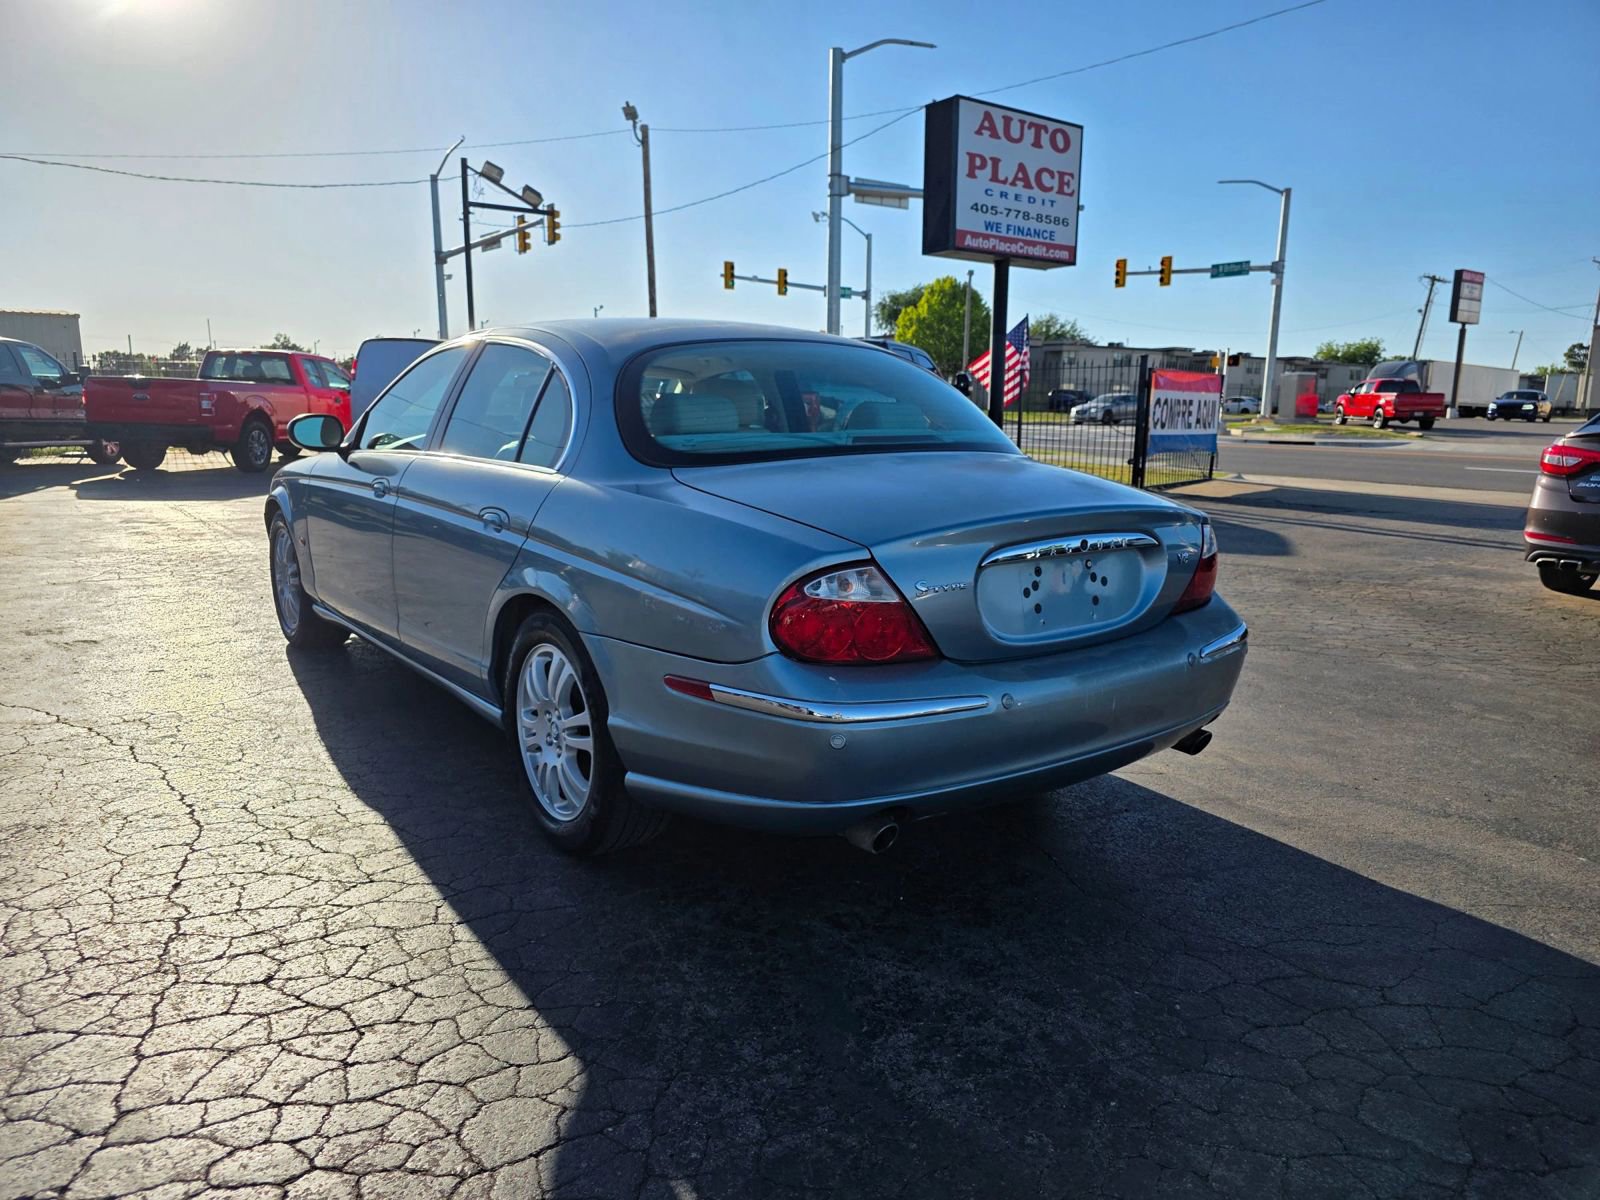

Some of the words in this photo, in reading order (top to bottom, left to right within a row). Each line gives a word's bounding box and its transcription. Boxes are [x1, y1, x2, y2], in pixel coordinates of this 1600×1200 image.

[974, 110, 1071, 154] AUTO
[965, 151, 1075, 197] PLACE
[984, 188, 1057, 208] CREDIT
[970, 202, 1070, 227] 405-778-8586
[984, 219, 1003, 234] WE
[1006, 223, 1056, 241] FINANCE
[964, 234, 1069, 259] AutoPlaceCredit.com
[1152, 397, 1194, 430] COMPRE
[1194, 399, 1217, 429] AQUI
